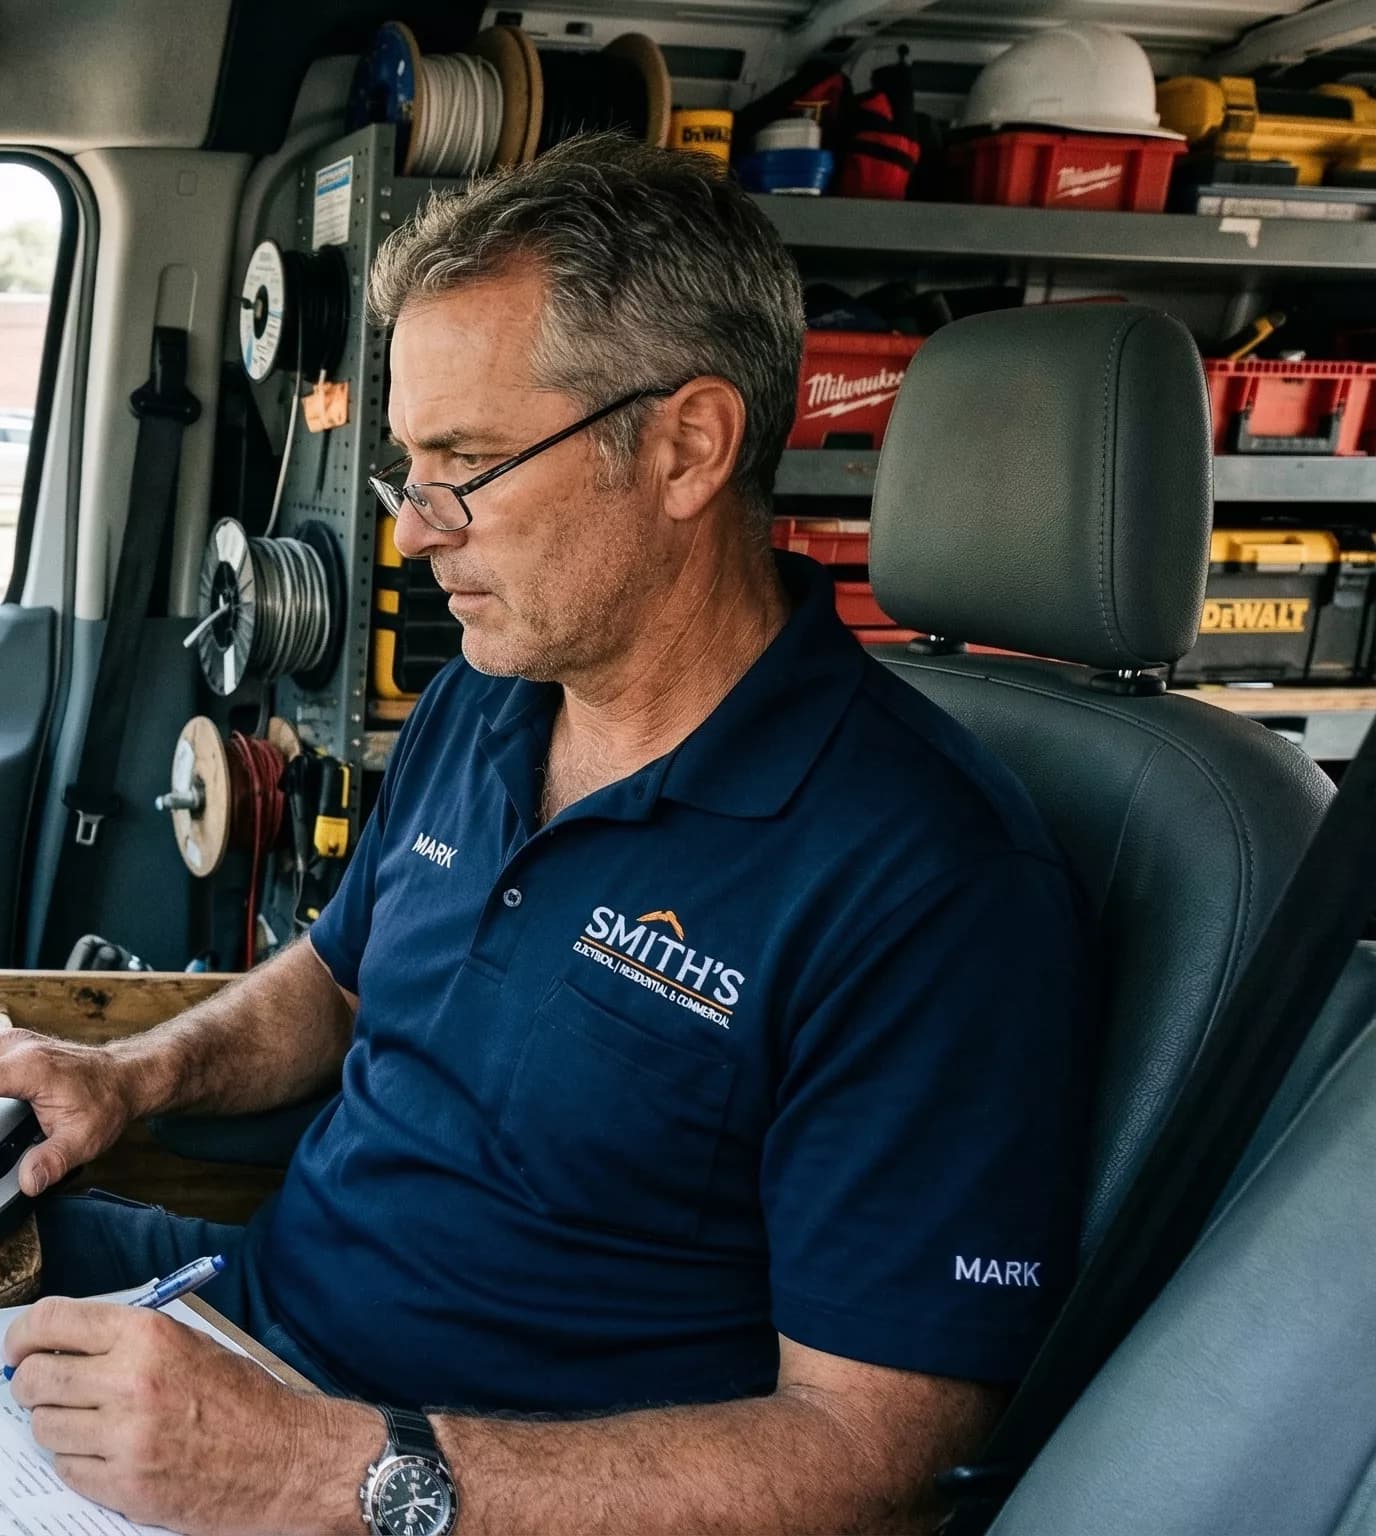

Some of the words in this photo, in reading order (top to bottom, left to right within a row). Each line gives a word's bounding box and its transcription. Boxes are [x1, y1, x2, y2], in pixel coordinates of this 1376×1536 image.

[411, 832, 458, 868] MARK
[584, 906, 746, 1006] SMITH'S
[955, 1255, 1041, 1287] MARK
